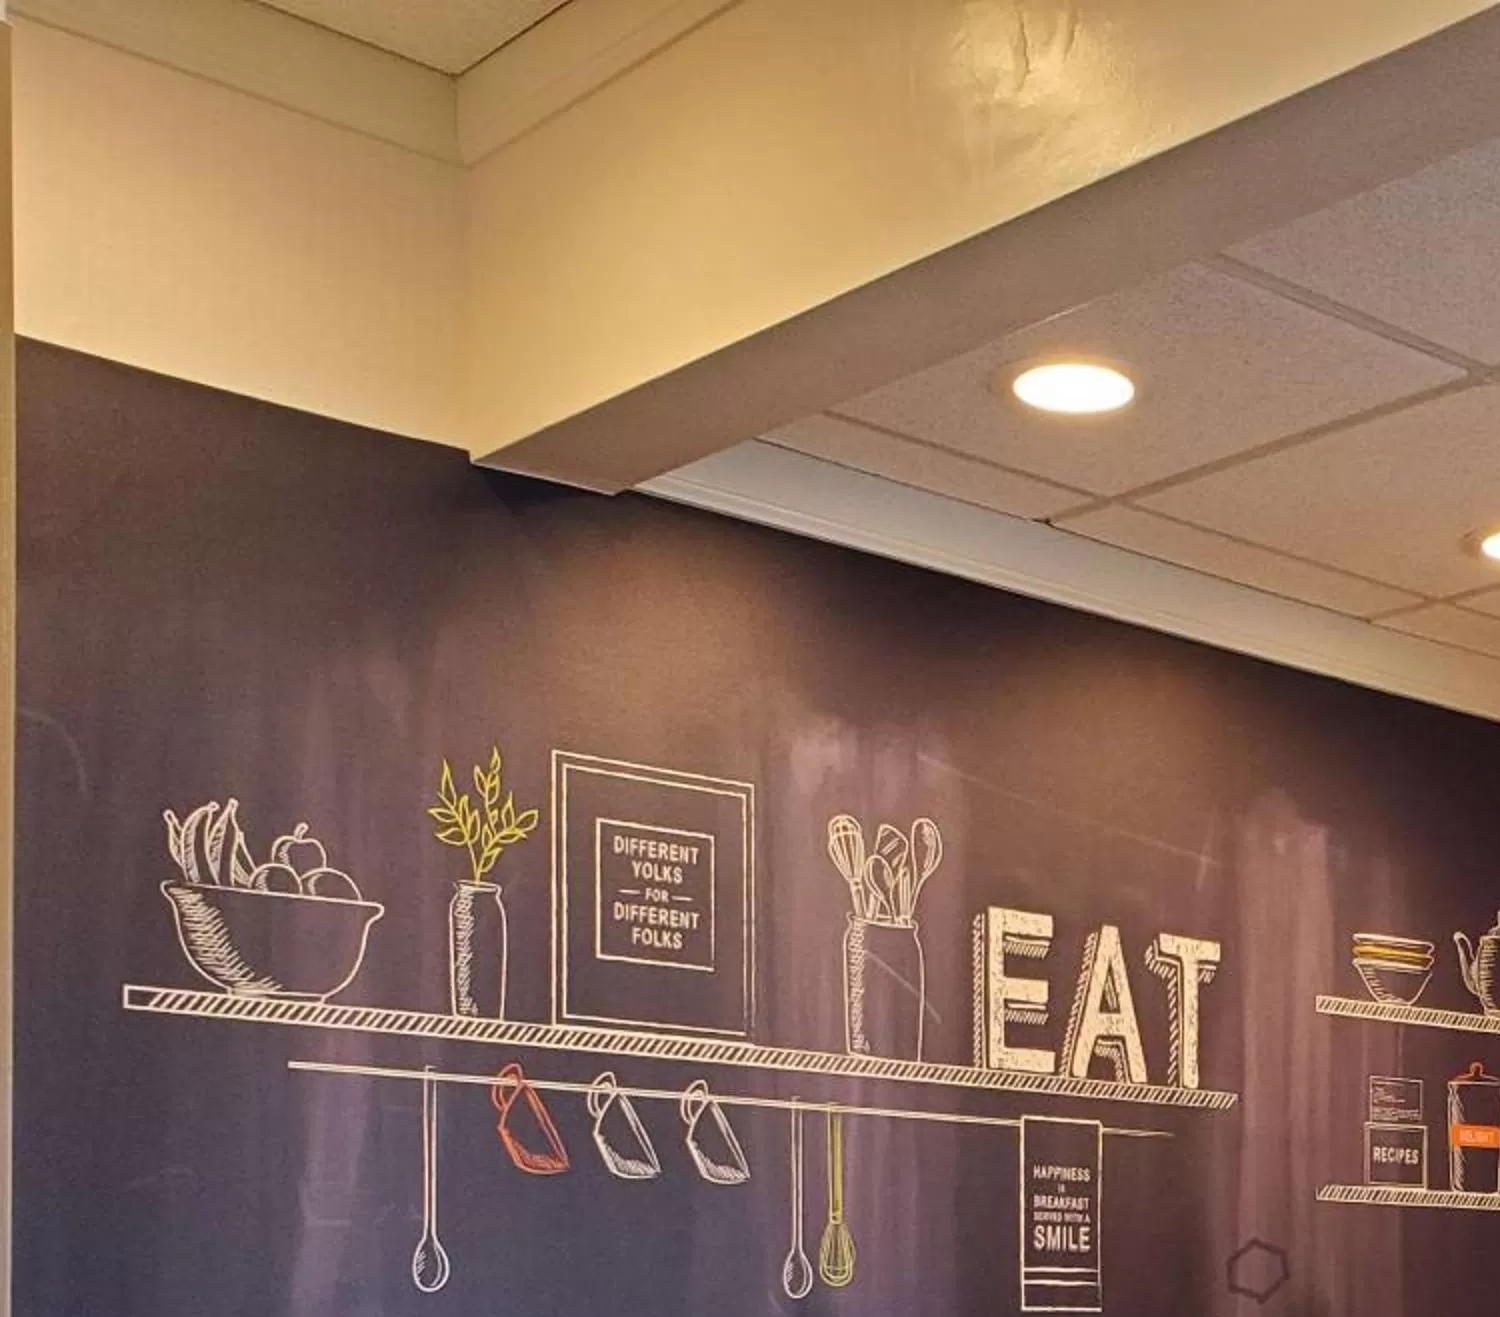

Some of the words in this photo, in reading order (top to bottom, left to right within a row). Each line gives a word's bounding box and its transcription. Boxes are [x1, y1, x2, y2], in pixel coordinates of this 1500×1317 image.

[613, 835, 699, 865] DIFFERENT
[632, 861, 683, 884] YOLKS
[645, 887, 669, 903] FOR
[613, 902, 700, 930] DIFFERENT
[632, 926, 683, 949] FOLKS
[973, 906, 1221, 1089] EAT
[1372, 1145, 1420, 1166] RECIPES
[1033, 1164, 1091, 1182] HAPPINESS
[1033, 1193, 1089, 1211] BREAKFAST
[1033, 1224, 1092, 1253] SMILE
